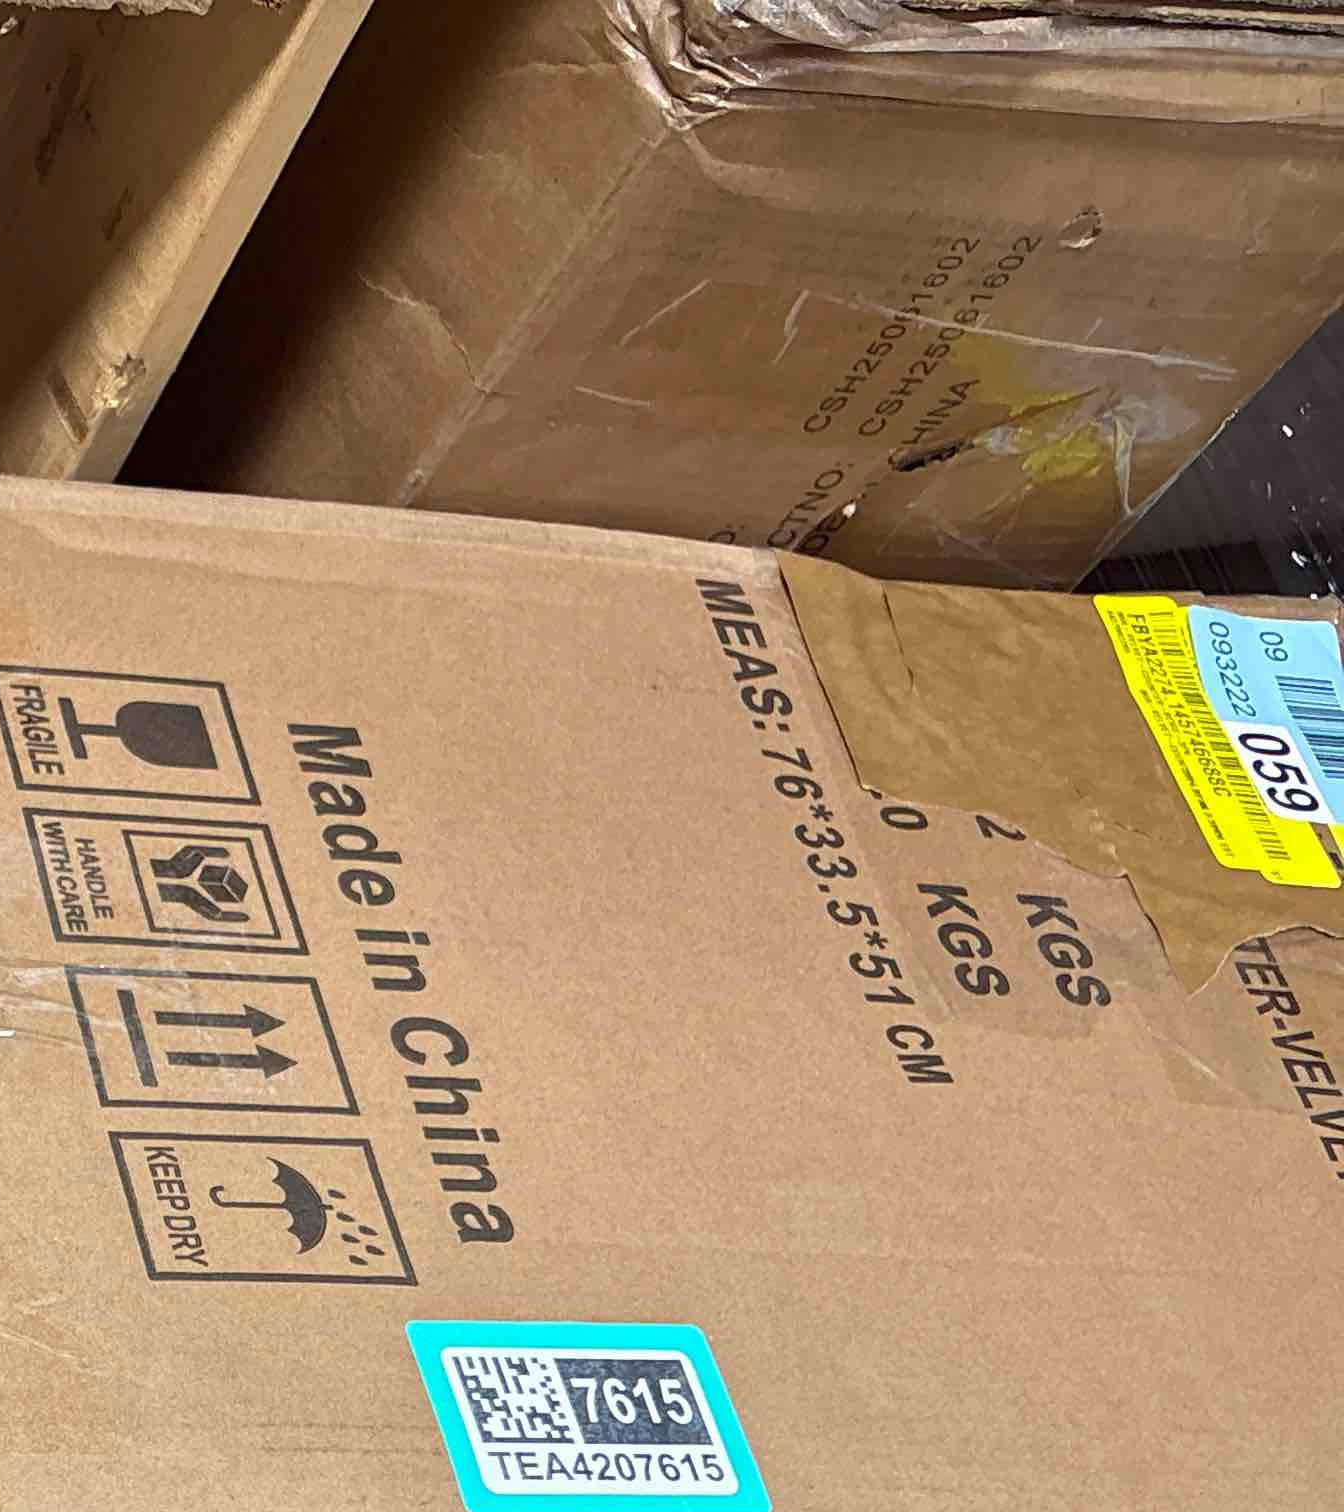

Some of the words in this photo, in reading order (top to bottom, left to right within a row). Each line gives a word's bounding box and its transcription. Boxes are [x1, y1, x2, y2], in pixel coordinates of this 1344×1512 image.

[695, 577, 796, 735] MEAS:
[1208, 620, 1257, 718] 093222
[1258, 630, 1289, 663] 09
[10, 683, 65, 777] FRAGILE
[1237, 732, 1320, 813] 059
[286, 723, 403, 907] Made
[41, 821, 71, 874] WITH
[57, 871, 89, 934] CARE
[75, 836, 115, 920] HANDLE
[354, 929, 431, 992] in
[916, 882, 1011, 998] KGS
[1015, 891, 1113, 1009] KGS
[390, 1015, 515, 1244] China
[143, 1146, 188, 1213] KEEP
[165, 1208, 209, 1268] DRY
[570, 1376, 694, 1426] 7615
[486, 1450, 726, 1483] TEA4207615
